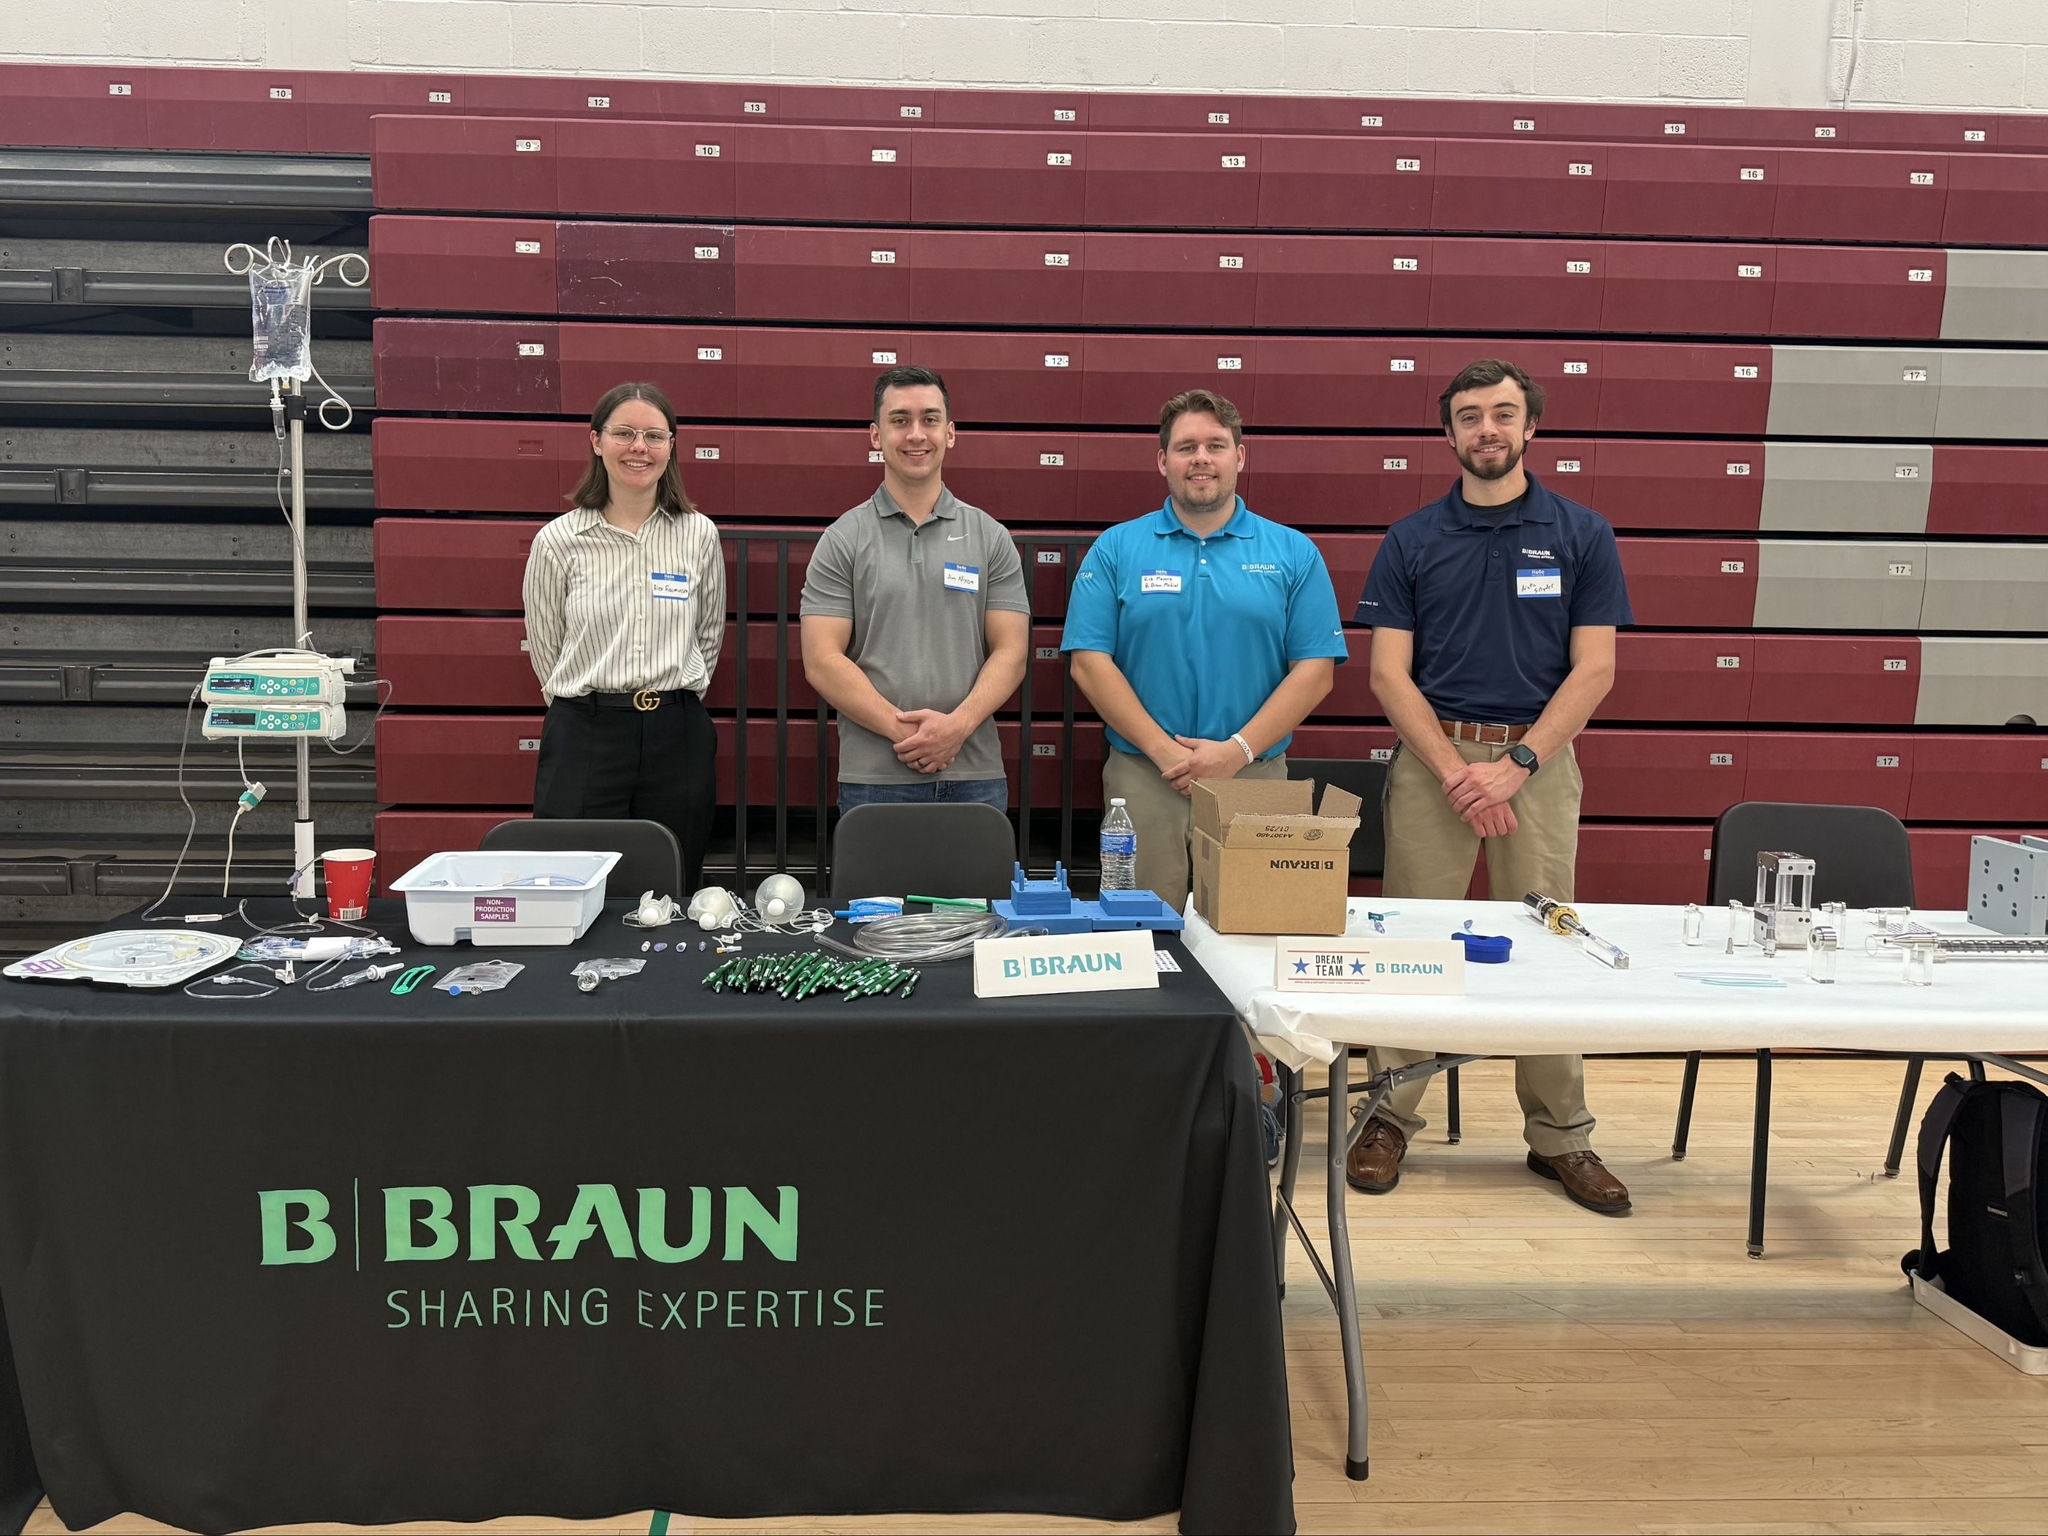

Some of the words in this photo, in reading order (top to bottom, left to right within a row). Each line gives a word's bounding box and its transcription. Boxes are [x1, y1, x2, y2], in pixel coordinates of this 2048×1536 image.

[117, 86, 123, 94] 9
[276, 89, 286, 98] 10
[595, 98, 604, 106] 12
[751, 104, 760, 112] 13
[907, 108, 916, 116] 14
[1060, 111, 1070, 120] 15
[1215, 114, 1224, 122] 16
[1368, 117, 1377, 125] 17
[1520, 121, 1529, 129] 18
[1671, 125, 1680, 133] 19
[1820, 128, 1831, 136] 20
[1970, 132, 1980, 140] 21
[525, 141, 532, 150] 9
[703, 147, 713, 156] 10
[1055, 155, 1065, 164] 12
[1229, 157, 1239, 166] 13
[1404, 161, 1413, 169] 14
[1576, 165, 1586, 174] 15
[1748, 170, 1758, 178] 16
[1918, 174, 1927, 183] 17
[702, 248, 713, 258] 10
[880, 253, 888, 262] 11
[1053, 256, 1063, 265] 12
[1227, 258, 1237, 267] 13
[1401, 260, 1410, 269] 14
[1574, 263, 1584, 272] 15
[1745, 267, 1755, 276] 16
[1915, 271, 1925, 280] 17
[528, 344, 535, 353] 9
[705, 350, 715, 358] 10
[1052, 357, 1063, 366] 12
[1225, 359, 1235, 367] 13
[1398, 362, 1408, 370] 14
[1571, 364, 1581, 373] 15
[1741, 368, 1751, 376] 16
[1910, 371, 1920, 380] 17
[703, 449, 713, 458] 10
[1047, 455, 1057, 464] 12
[1391, 460, 1401, 468] 14
[1564, 462, 1574, 470] 15
[1734, 465, 1744, 474] 16
[1902, 467, 1912, 476] 17
[1045, 553, 1055, 562] 12
[1728, 563, 1738, 571] 16
[1896, 566, 1905, 574] 17
[1043, 649, 1053, 657] 12
[1724, 658, 1733, 667] 16
[1891, 661, 1900, 669] 17
[528, 740, 534, 749] 9
[1039, 746, 1050, 754] 12
[1376, 750, 1387, 758] 14
[1717, 755, 1727, 764] 16
[1883, 757, 1893, 766] 17
[1270, 859, 1320, 870] BRAUN
[1315, 954, 1343, 965] DREAM
[1003, 958, 1021, 978] B
[1030, 952, 1122, 977] BRAUN
[1390, 963, 1443, 974] BRAUN
[1315, 965, 1343, 977] TEAM
[257, 1188, 337, 1265] B
[382, 1182, 800, 1264] BRAUN
[386, 1287, 610, 1329] SHARING
[637, 1288, 885, 1331] EXPERTISE
